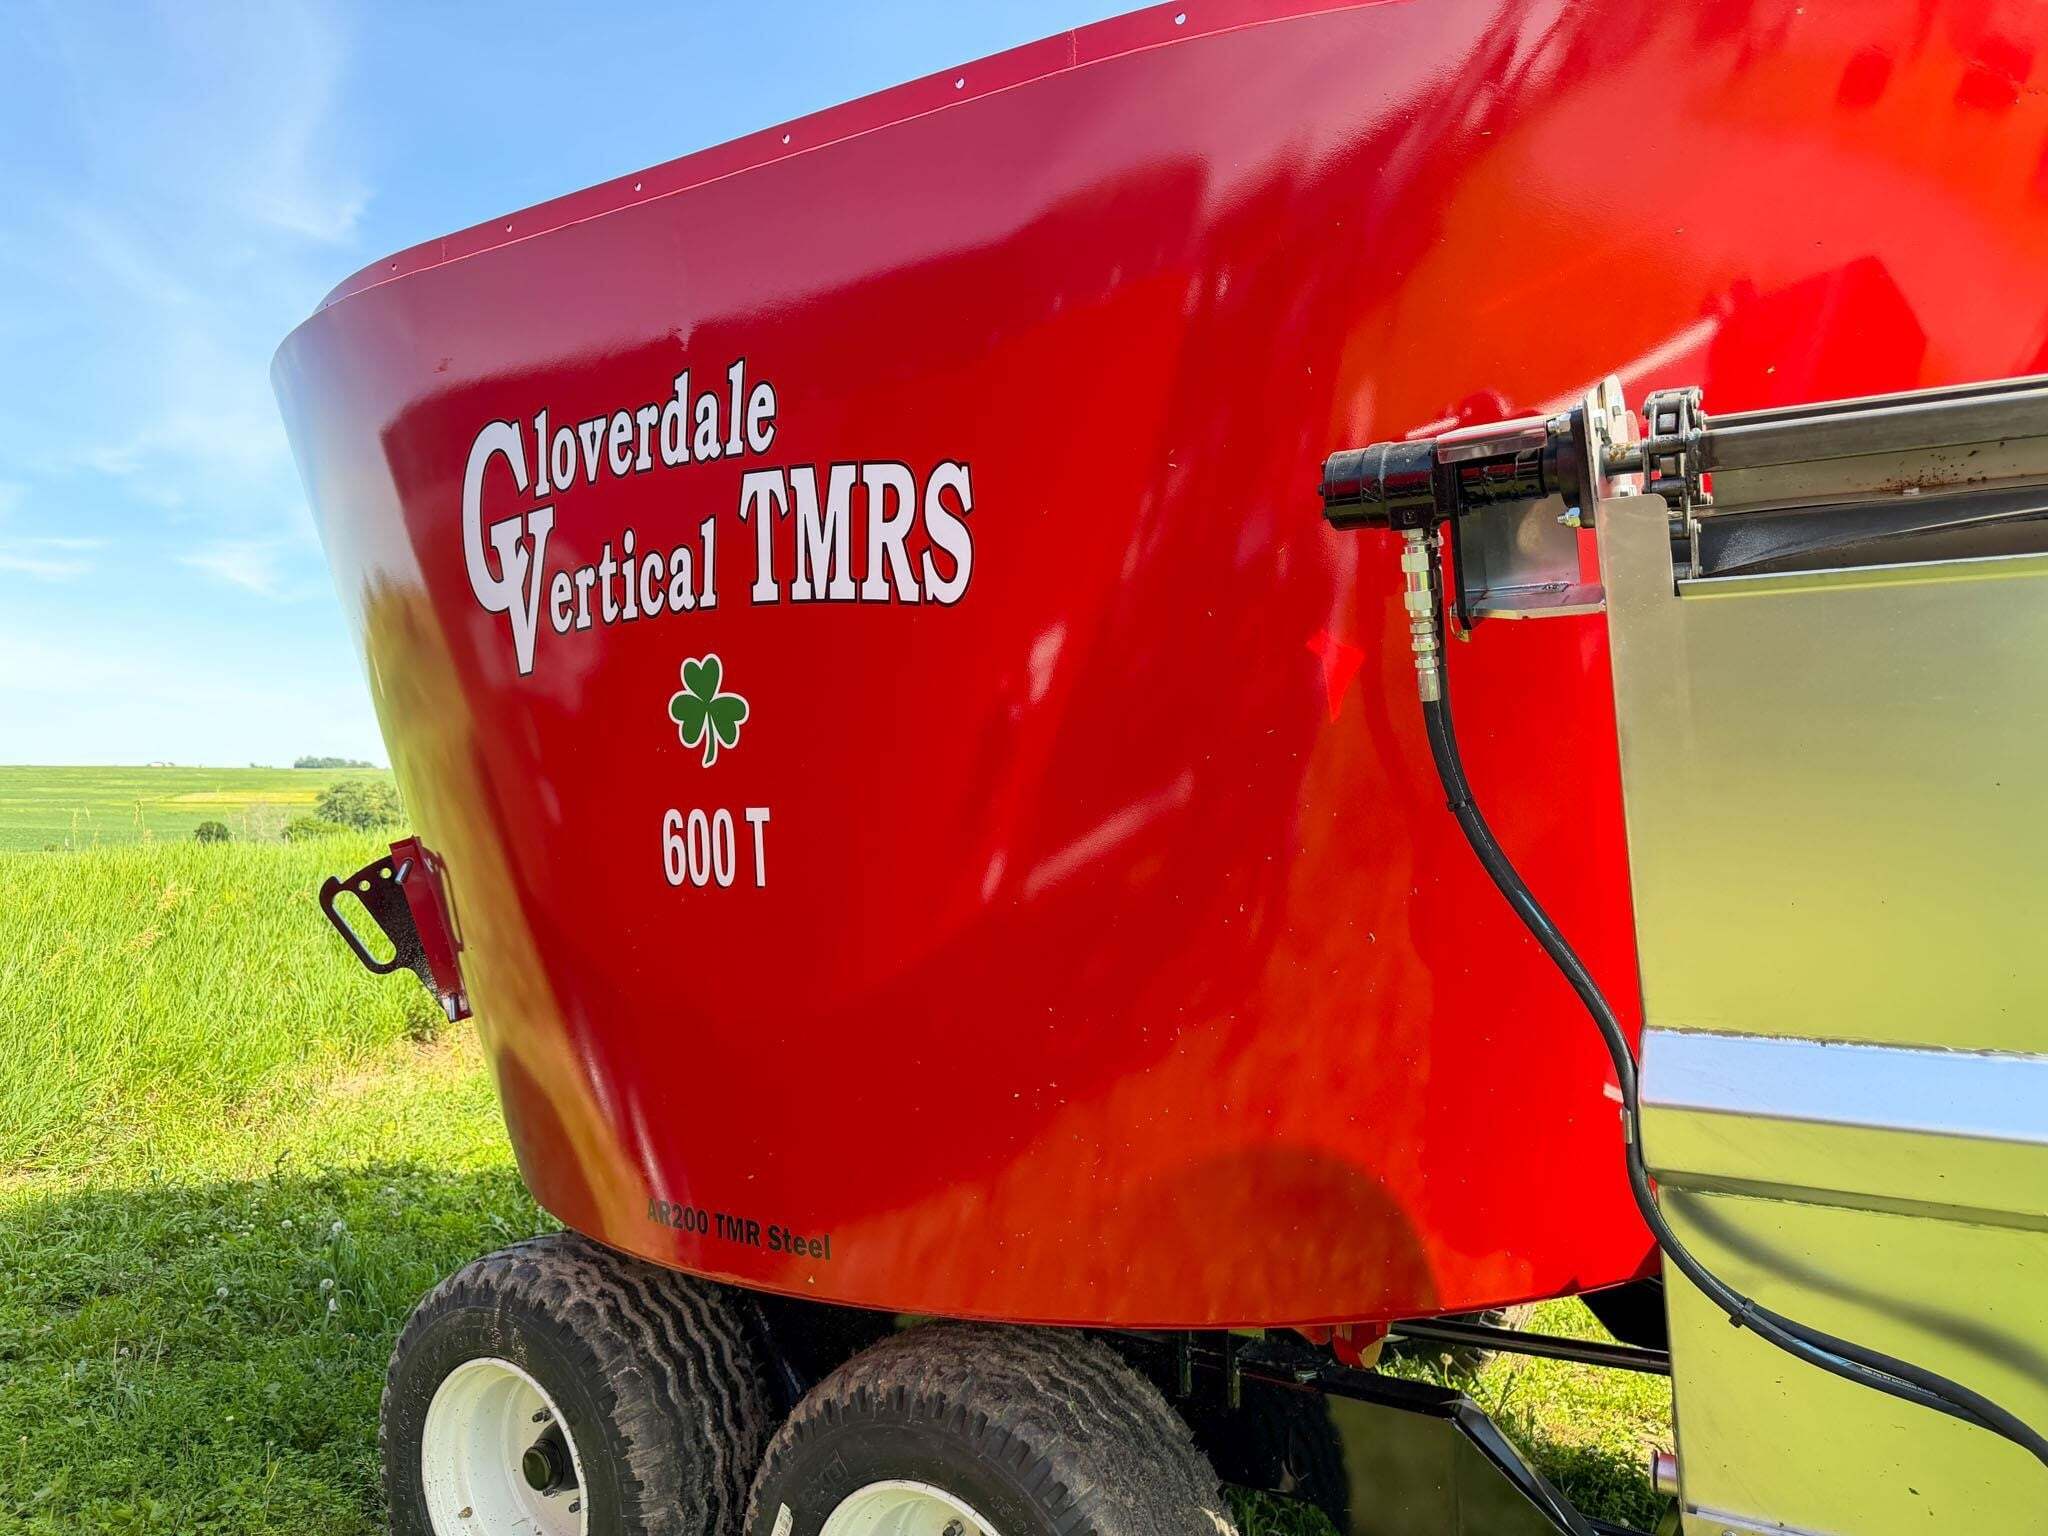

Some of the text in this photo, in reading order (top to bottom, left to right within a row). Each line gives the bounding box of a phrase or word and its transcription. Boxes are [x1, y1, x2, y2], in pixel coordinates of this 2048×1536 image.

[490, 459, 975, 676] Vertical TMRS
[662, 806, 771, 887] 600 T
[647, 1198, 832, 1261] AR200 TMR Steel
